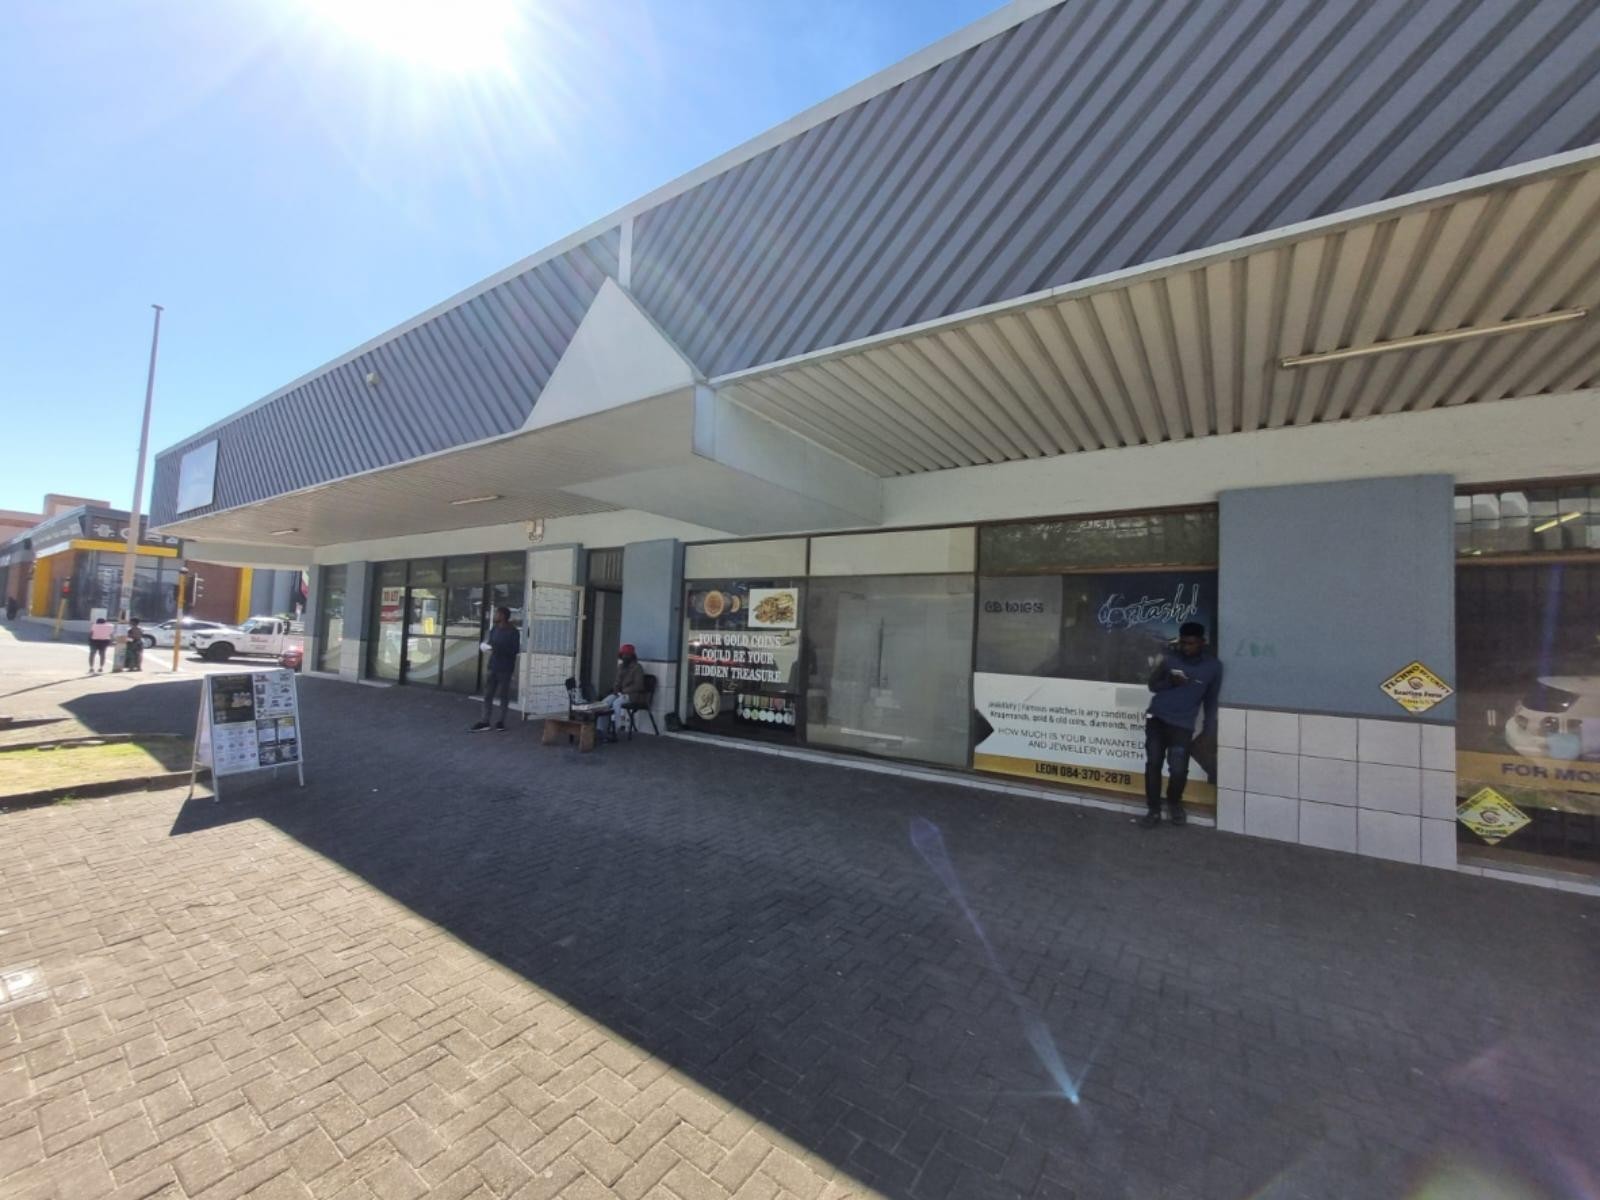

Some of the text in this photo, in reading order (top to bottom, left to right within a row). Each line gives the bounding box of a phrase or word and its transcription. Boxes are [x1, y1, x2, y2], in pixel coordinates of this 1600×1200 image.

[698, 633, 781, 648] YOUR GOLD COINS
[702, 649, 774, 664] COULD BE YOUR
[695, 665, 782, 682] HIDDEN TREASURE
[998, 727, 1145, 750] HOW MUCH IS YOUR UNWANTED
[1029, 740, 1143, 761] AND JEWELLERY WORTH
[1035, 763, 1058, 775] LEON
[1502, 763, 1548, 779] FOR
